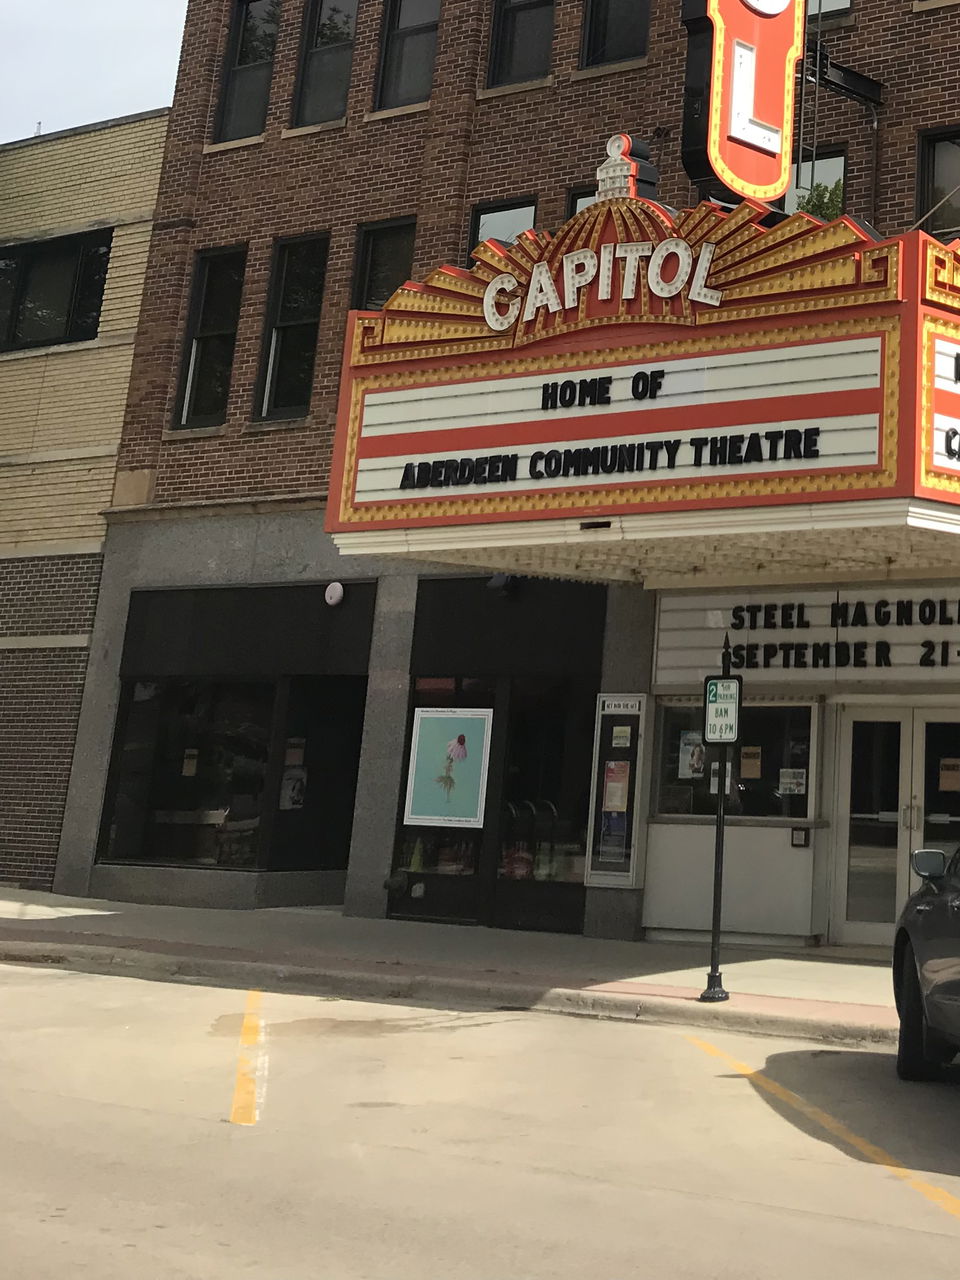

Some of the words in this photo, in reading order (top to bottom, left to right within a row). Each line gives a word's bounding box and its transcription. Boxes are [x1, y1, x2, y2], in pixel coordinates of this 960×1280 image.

[483, 238, 723, 331] CAPITOL
[541, 375, 612, 410] HOME
[632, 370, 664, 400] OF
[400, 453, 516, 489] ABERDEEN
[529, 438, 680, 480] COMMUNITY
[689, 427, 821, 467] THEATRE
[731, 603, 810, 630] STEEL
[731, 641, 892, 669] SEPTEMBER
[709, 685, 717, 701] 2
[714, 707, 729, 719] 8AM
[709, 723, 717, 735] TO
